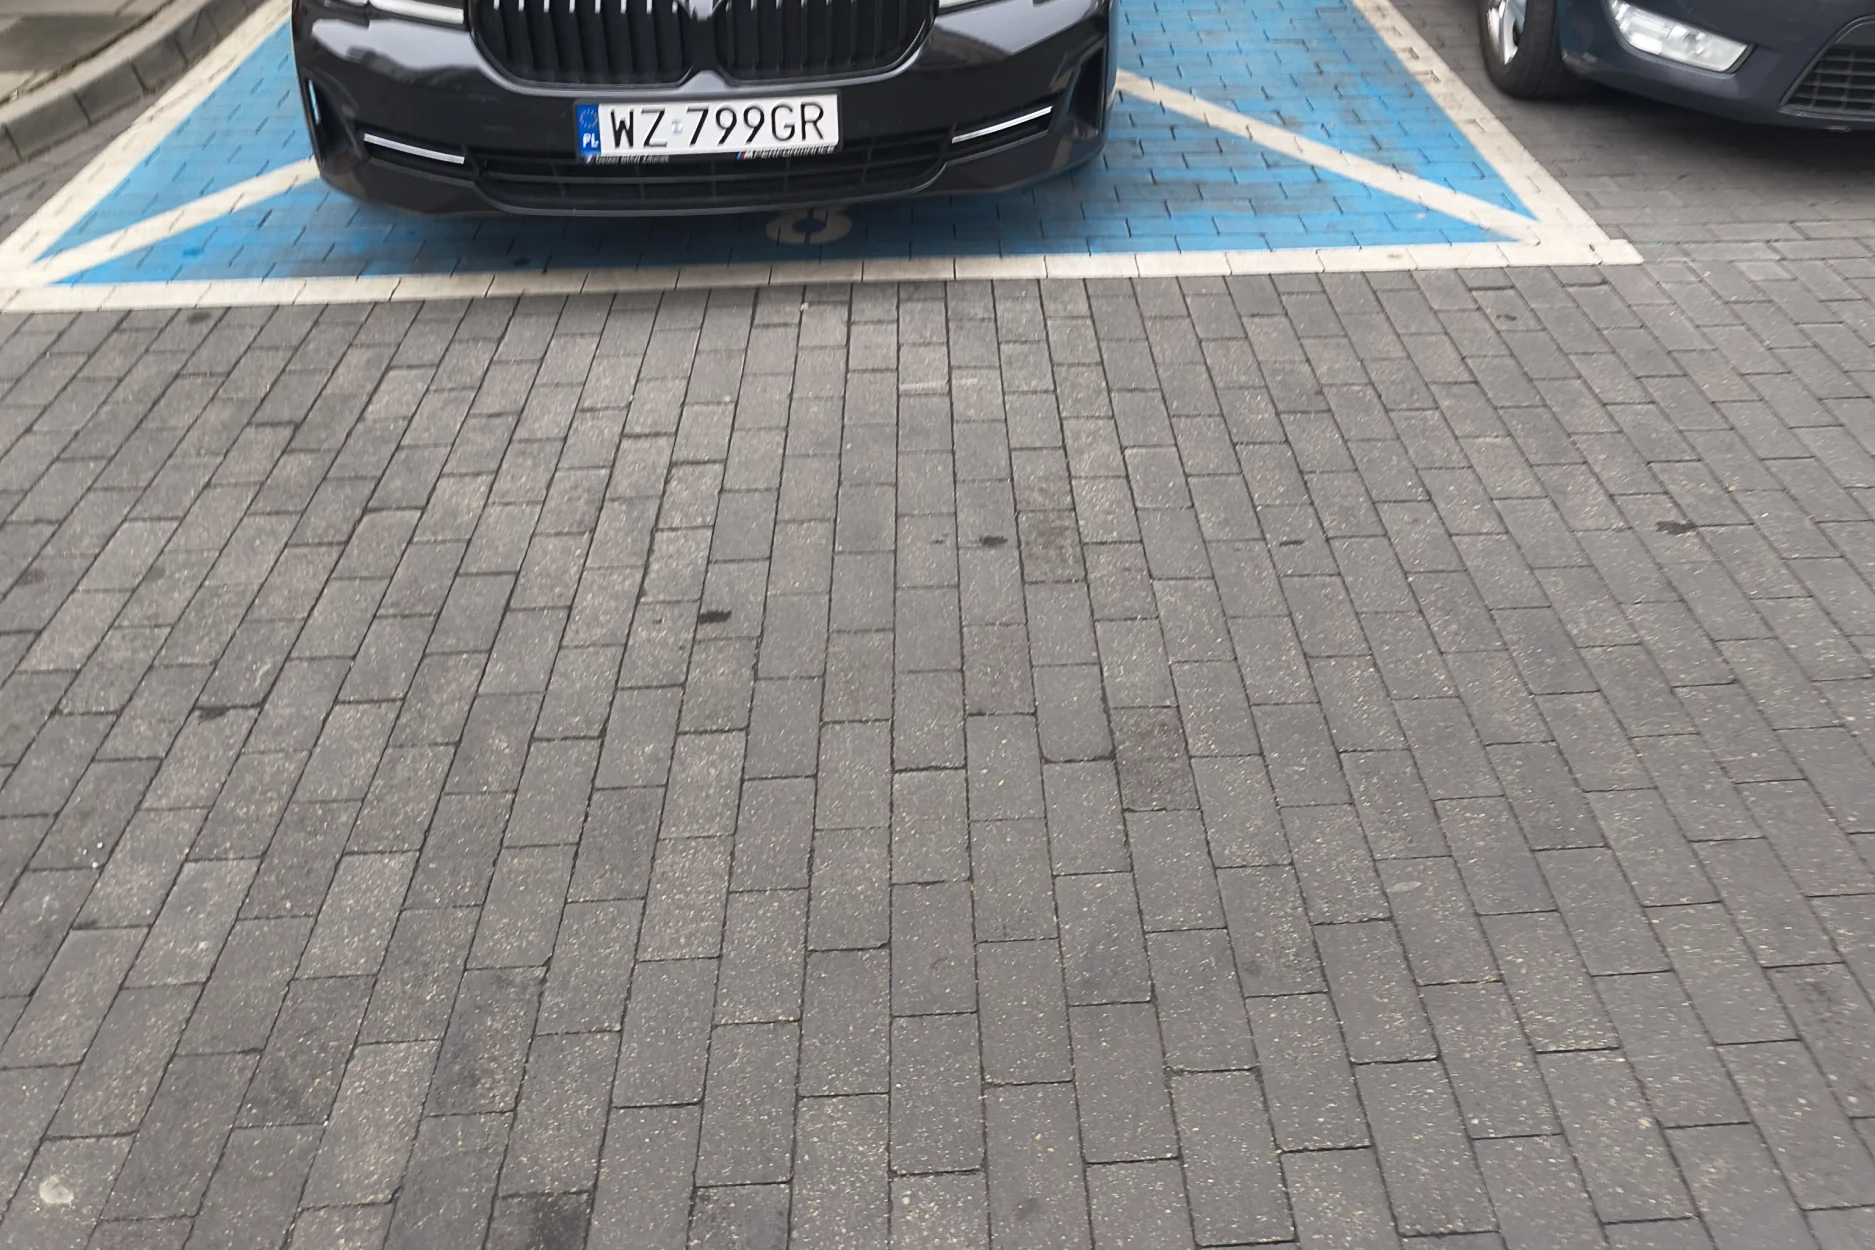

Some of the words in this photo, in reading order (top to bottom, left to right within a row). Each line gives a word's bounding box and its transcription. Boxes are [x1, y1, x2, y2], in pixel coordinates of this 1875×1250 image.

[582, 132, 600, 148] PL
[611, 107, 668, 149] WZ
[686, 102, 825, 147] 799GR
